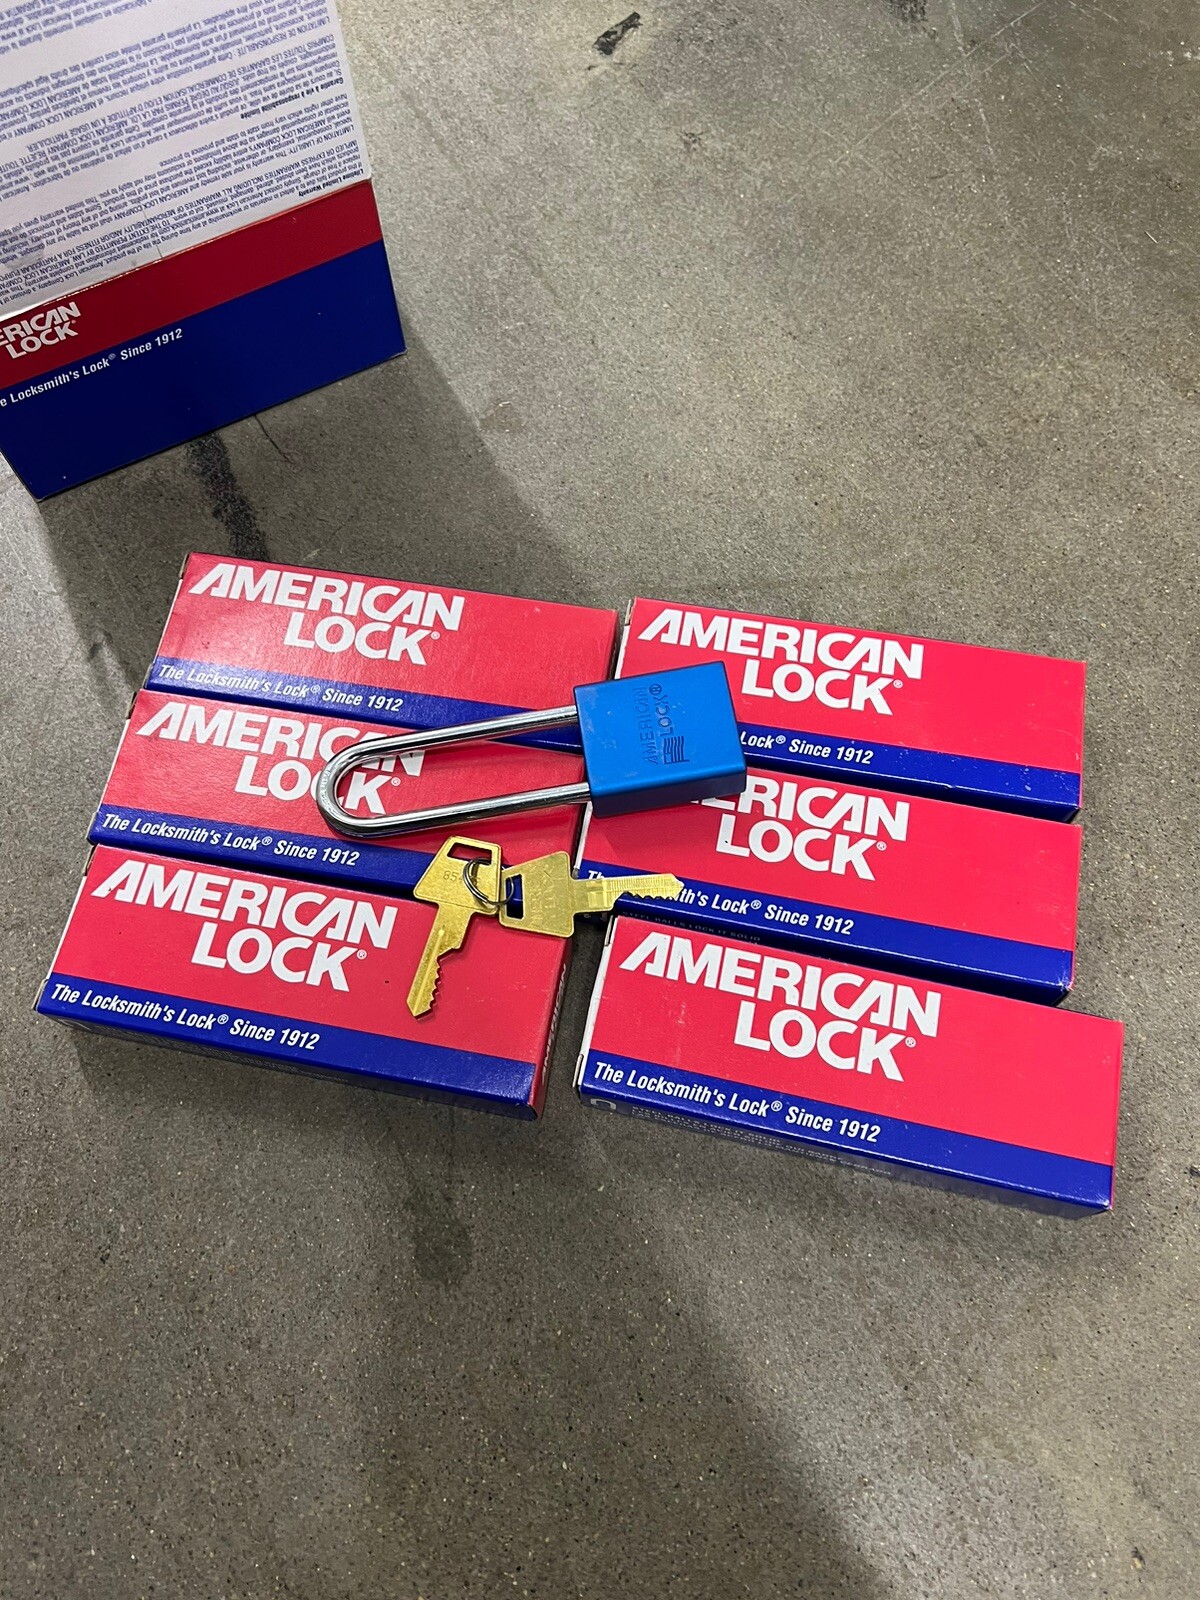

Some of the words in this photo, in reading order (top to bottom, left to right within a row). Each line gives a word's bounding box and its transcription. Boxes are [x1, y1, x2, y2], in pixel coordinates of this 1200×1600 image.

[11, 369, 80, 403] Locksmith's
[121, 340, 152, 361] Since
[155, 328, 183, 348] 1912
[189, 563, 464, 631] AMERICAN
[639, 607, 924, 679] AMERICAN
[159, 665, 185, 682] The
[187, 669, 272, 697] Locksmith's
[322, 688, 365, 708] Since
[367, 695, 403, 713] 1912
[789, 737, 831, 757] Since
[836, 744, 874, 765] 1912
[102, 813, 129, 832] The
[132, 817, 221, 846] Locksmith's
[274, 839, 319, 860] Since
[321, 846, 359, 866] 1912
[690, 775, 911, 843] RICAN
[91, 859, 398, 950] AMERICAN
[764, 903, 810, 928] Since
[815, 912, 854, 936] 1912
[50, 983, 80, 1004] The
[82, 988, 174, 1023] Locksmith's
[230, 1018, 277, 1042] Since
[280, 1027, 320, 1051] 1912
[620, 932, 941, 1038] AMERICAN
[594, 1061, 624, 1083] The
[626, 1068, 726, 1106] Locksmith's
[785, 1105, 834, 1133] Since
[838, 1117, 881, 1143] 1912
